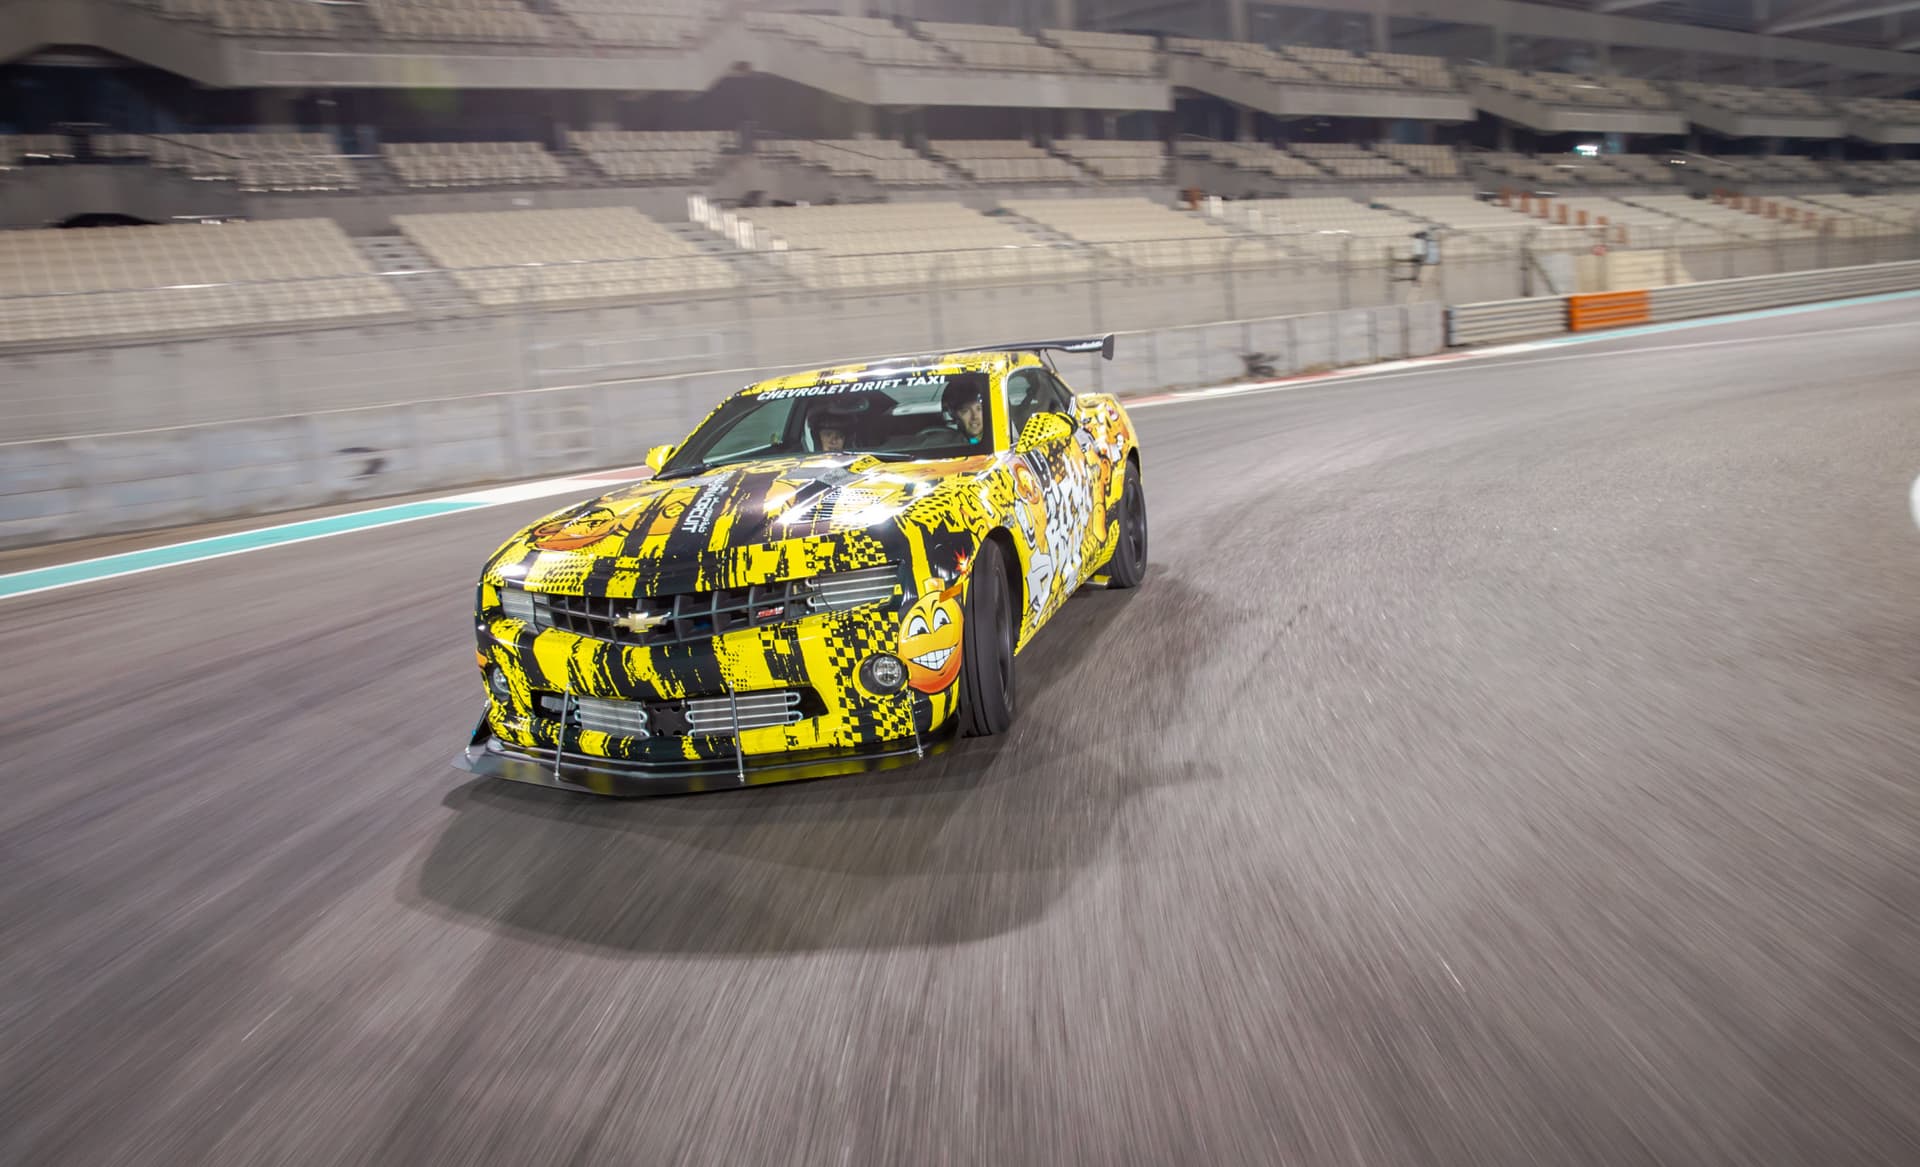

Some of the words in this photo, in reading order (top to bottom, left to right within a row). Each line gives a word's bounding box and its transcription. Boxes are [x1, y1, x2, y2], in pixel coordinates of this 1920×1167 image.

[757, 384, 849, 400] CHEVROLET
[850, 379, 902, 392] DRIFT
[906, 376, 946, 387] TAXI
